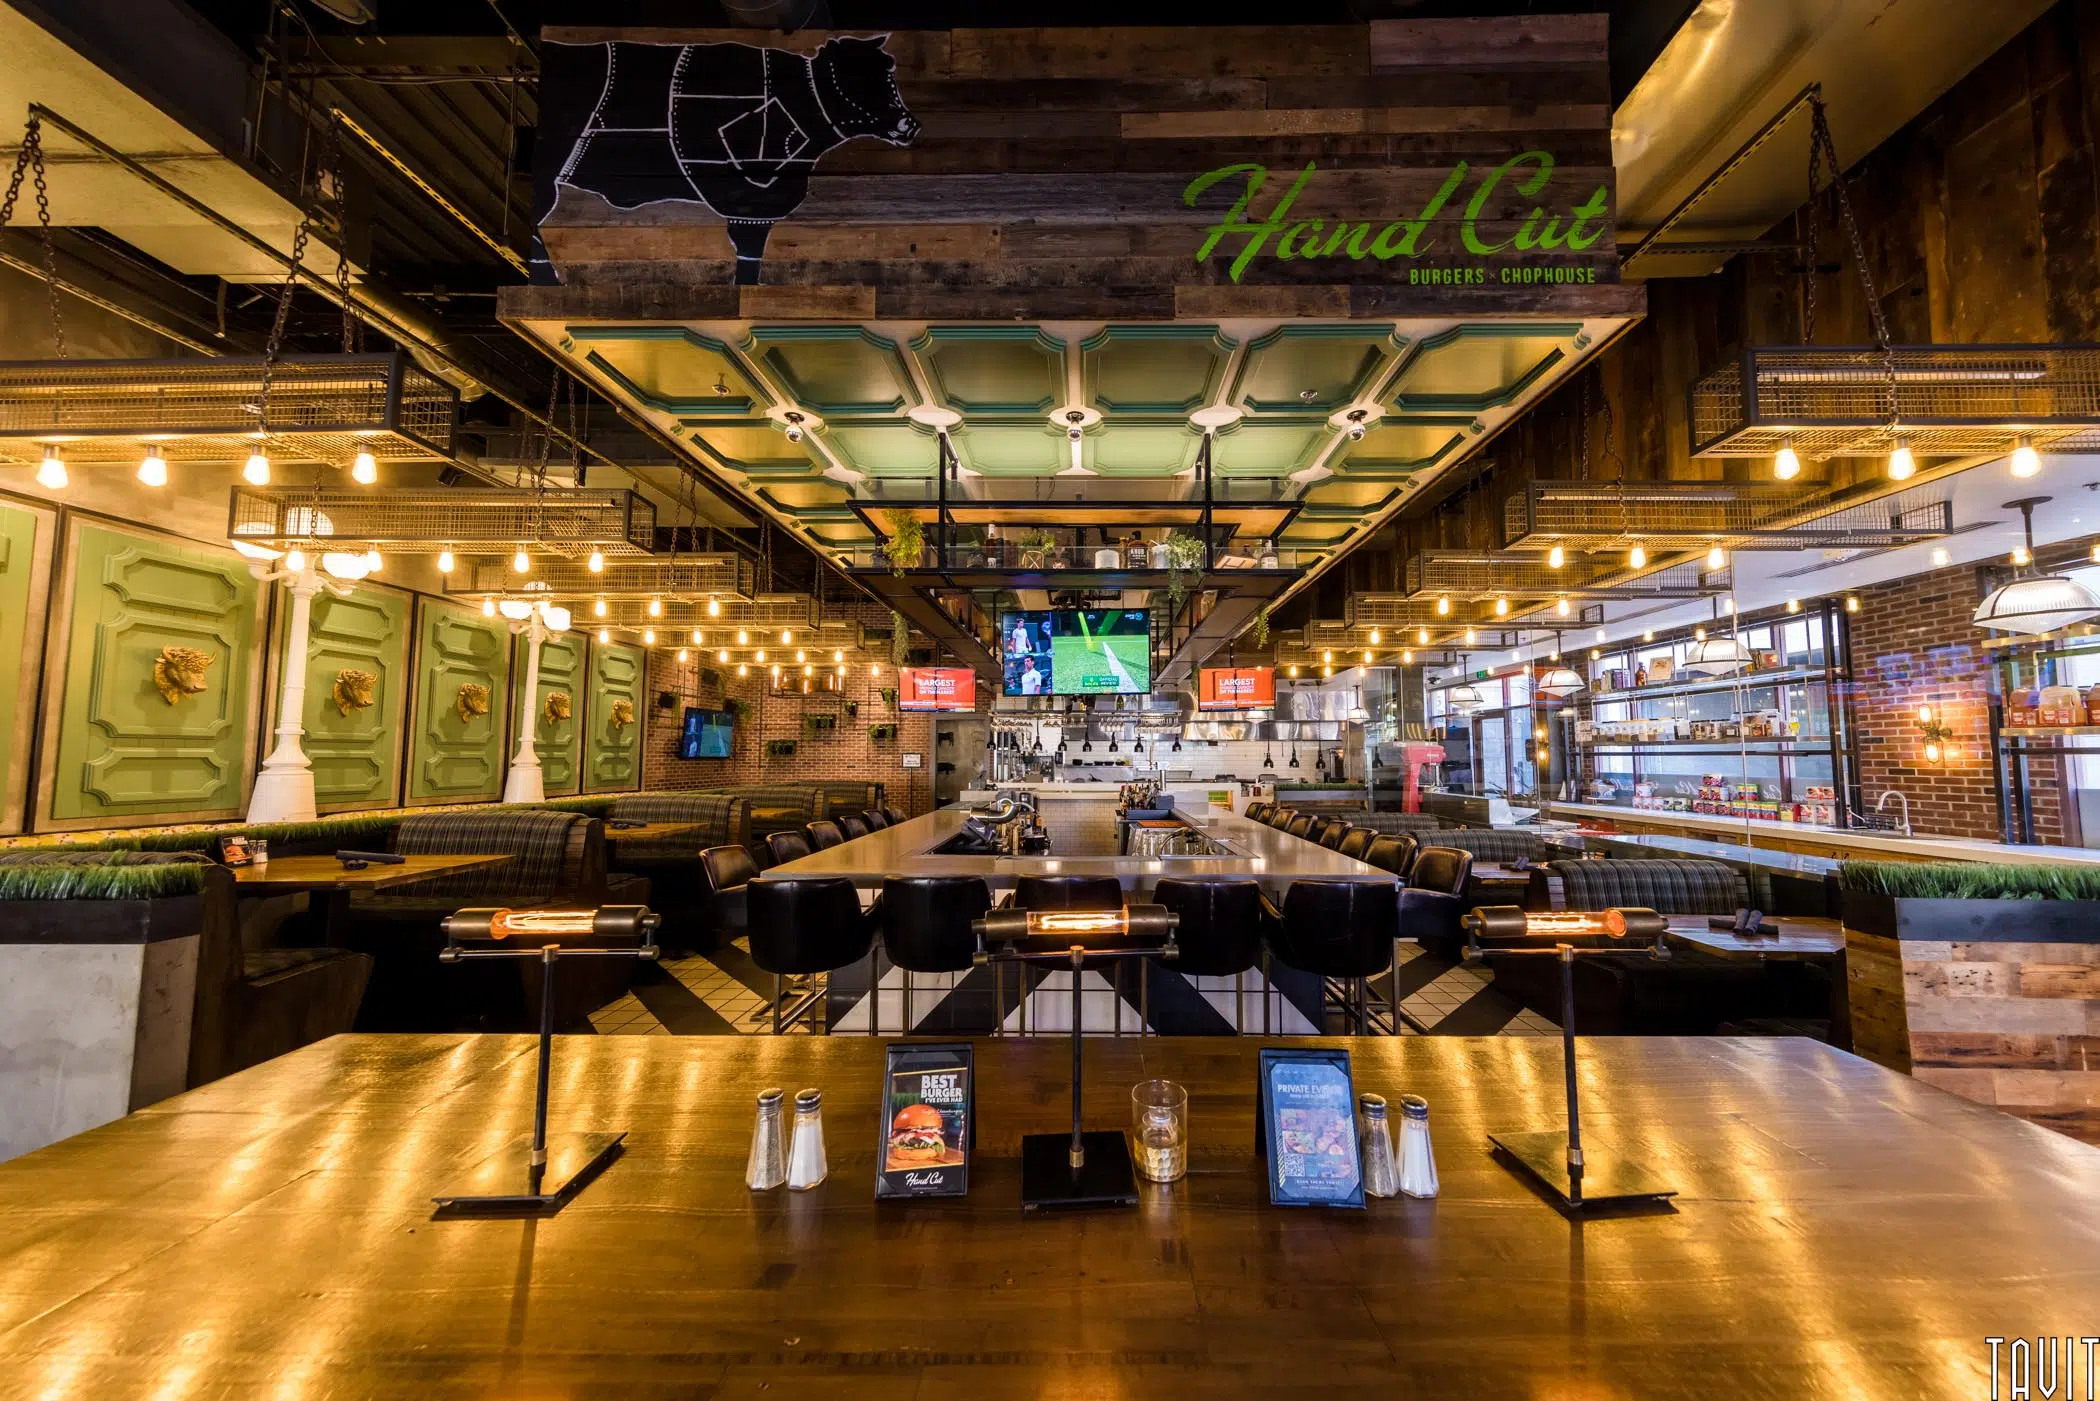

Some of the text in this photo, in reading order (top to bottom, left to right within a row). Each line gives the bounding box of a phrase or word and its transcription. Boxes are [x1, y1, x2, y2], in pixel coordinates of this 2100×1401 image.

[1183, 151, 1607, 283] Hand Cut
[1409, 267, 1595, 285] BURGERS CHOPHOUSE
[1219, 678, 1255, 686] LARGEST
[922, 1075, 957, 1089] BEST
[1277, 1084, 1309, 1093] PRIVATE
[921, 1087, 962, 1098] BURGER
[905, 1171, 943, 1186] Hand Cut
